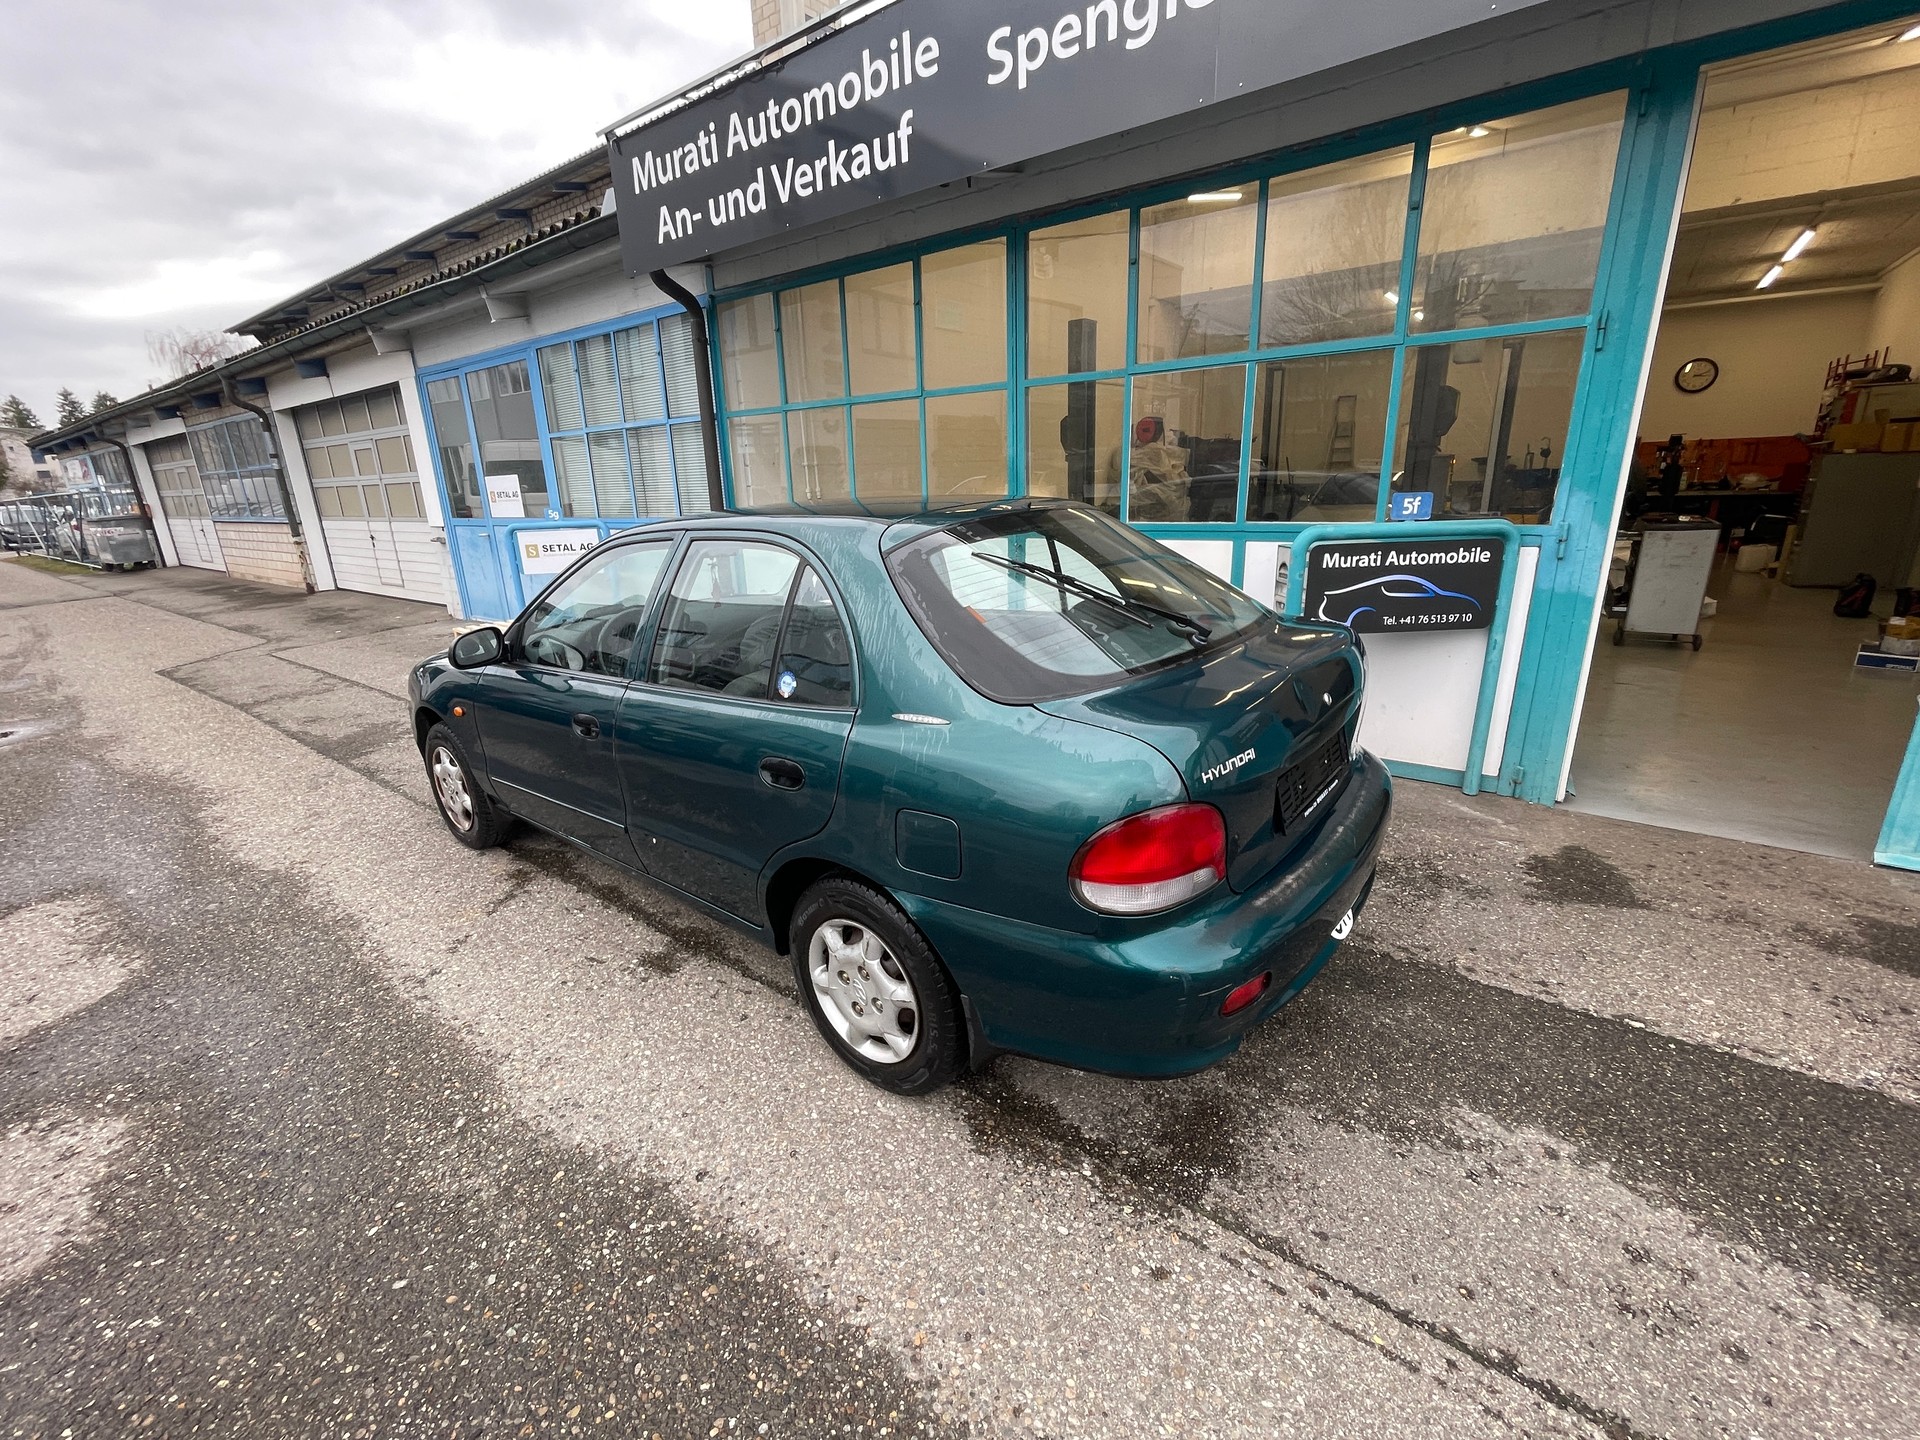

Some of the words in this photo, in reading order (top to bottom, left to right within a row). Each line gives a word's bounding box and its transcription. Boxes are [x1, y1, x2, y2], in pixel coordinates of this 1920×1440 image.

[986, 0, 1215, 90] Speng
[632, 123, 719, 195] Murati
[726, 31, 940, 158] Automobile
[657, 205, 703, 245] An-
[708, 167, 766, 224] und
[771, 109, 915, 202] Verkauf
[548, 509, 559, 521] 5g
[1402, 497, 1421, 515] 5f
[542, 544, 576, 553] SETAL
[579, 542, 594, 551] AG
[1322, 551, 1382, 569] Murati
[1385, 546, 1491, 567] Automobile
[1382, 615, 1397, 626] Tel.
[1399, 615, 1415, 625] +41
[1418, 614, 1429, 624] 76
[1430, 614, 1447, 624] 513
[1448, 613, 1459, 623] 97
[1461, 613, 1473, 622] 10
[1201, 748, 1256, 784] HYUNDAI
